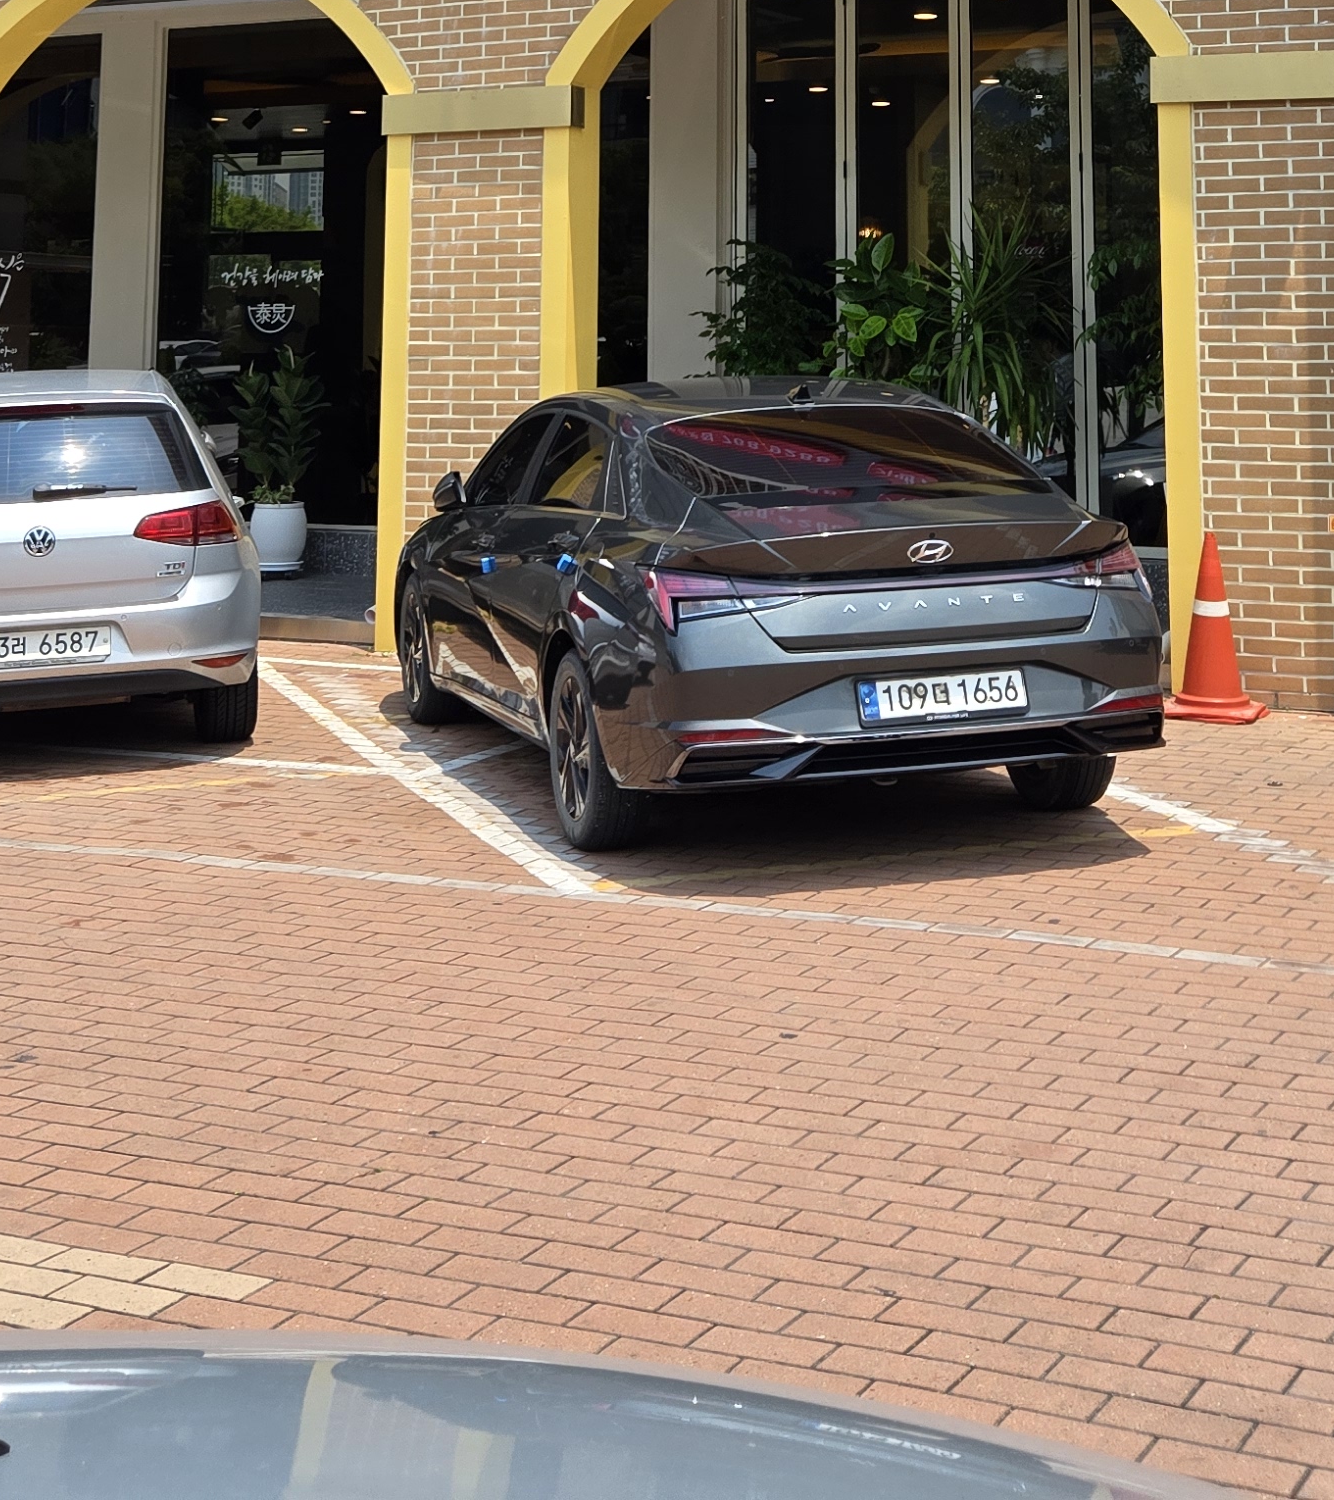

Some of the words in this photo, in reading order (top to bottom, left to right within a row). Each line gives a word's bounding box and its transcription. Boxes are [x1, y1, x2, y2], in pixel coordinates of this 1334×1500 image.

[843, 592, 1025, 614] AVANTE
[39, 630, 99, 655] 6587
[956, 674, 1019, 706] 1656
